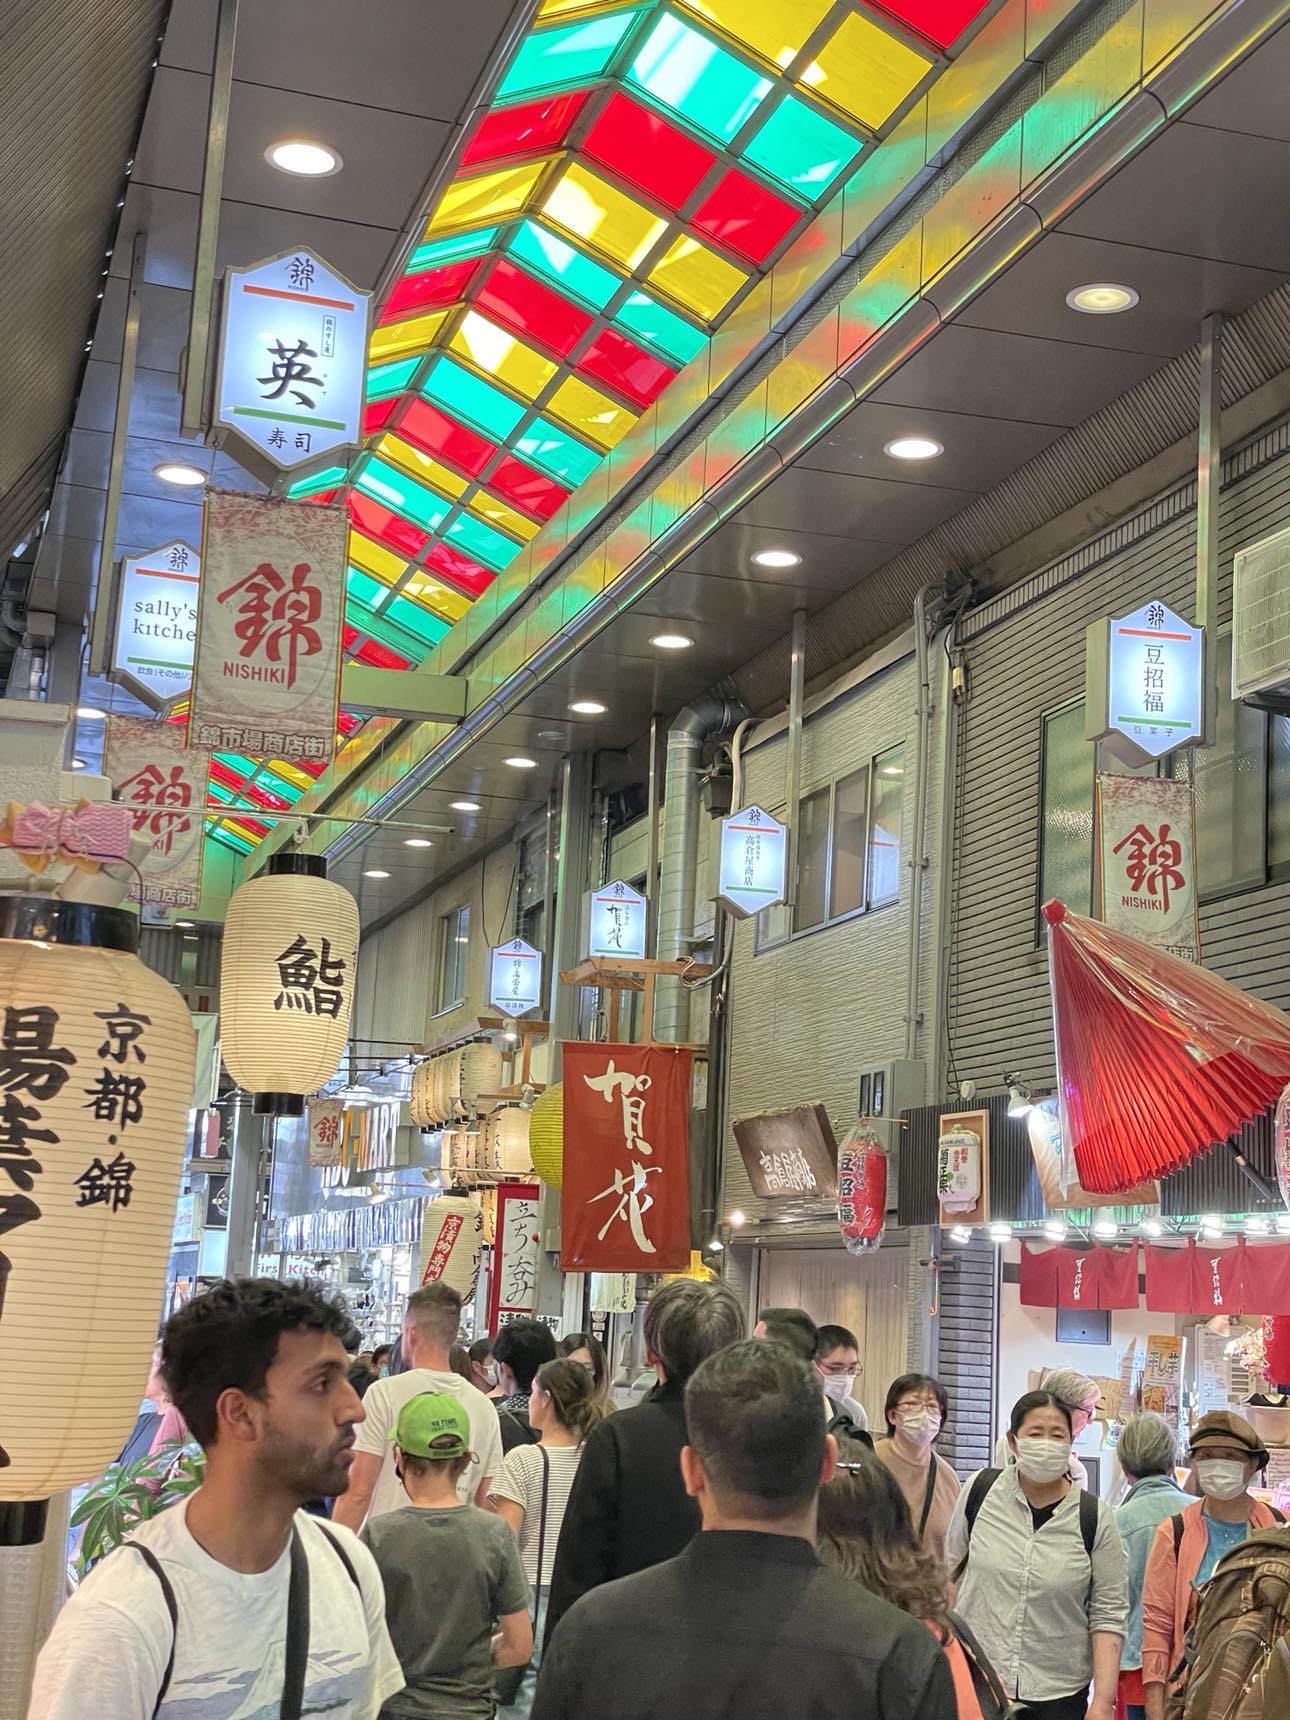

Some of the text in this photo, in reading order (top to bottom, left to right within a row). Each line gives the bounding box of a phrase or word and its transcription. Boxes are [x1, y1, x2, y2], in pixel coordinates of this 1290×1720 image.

[257, 339, 325, 410] 英
[268, 427, 312, 453] 寿司
[133, 618, 196, 641] kitche
[134, 600, 197, 621] sally's
[217, 562, 323, 690] 錦
[223, 661, 285, 684] NISHIKI
[1144, 644, 1165, 712] 豆招福
[199, 724, 326, 757] 錦市場商店街
[116, 764, 192, 856] 錦
[1112, 824, 1186, 915] 錦
[1122, 895, 1162, 911] NISHIKI
[274, 932, 346, 1019] 鮨
[584, 1059, 662, 1253] 賀花
[505, 1201, 538, 1306] 立ち呑み
